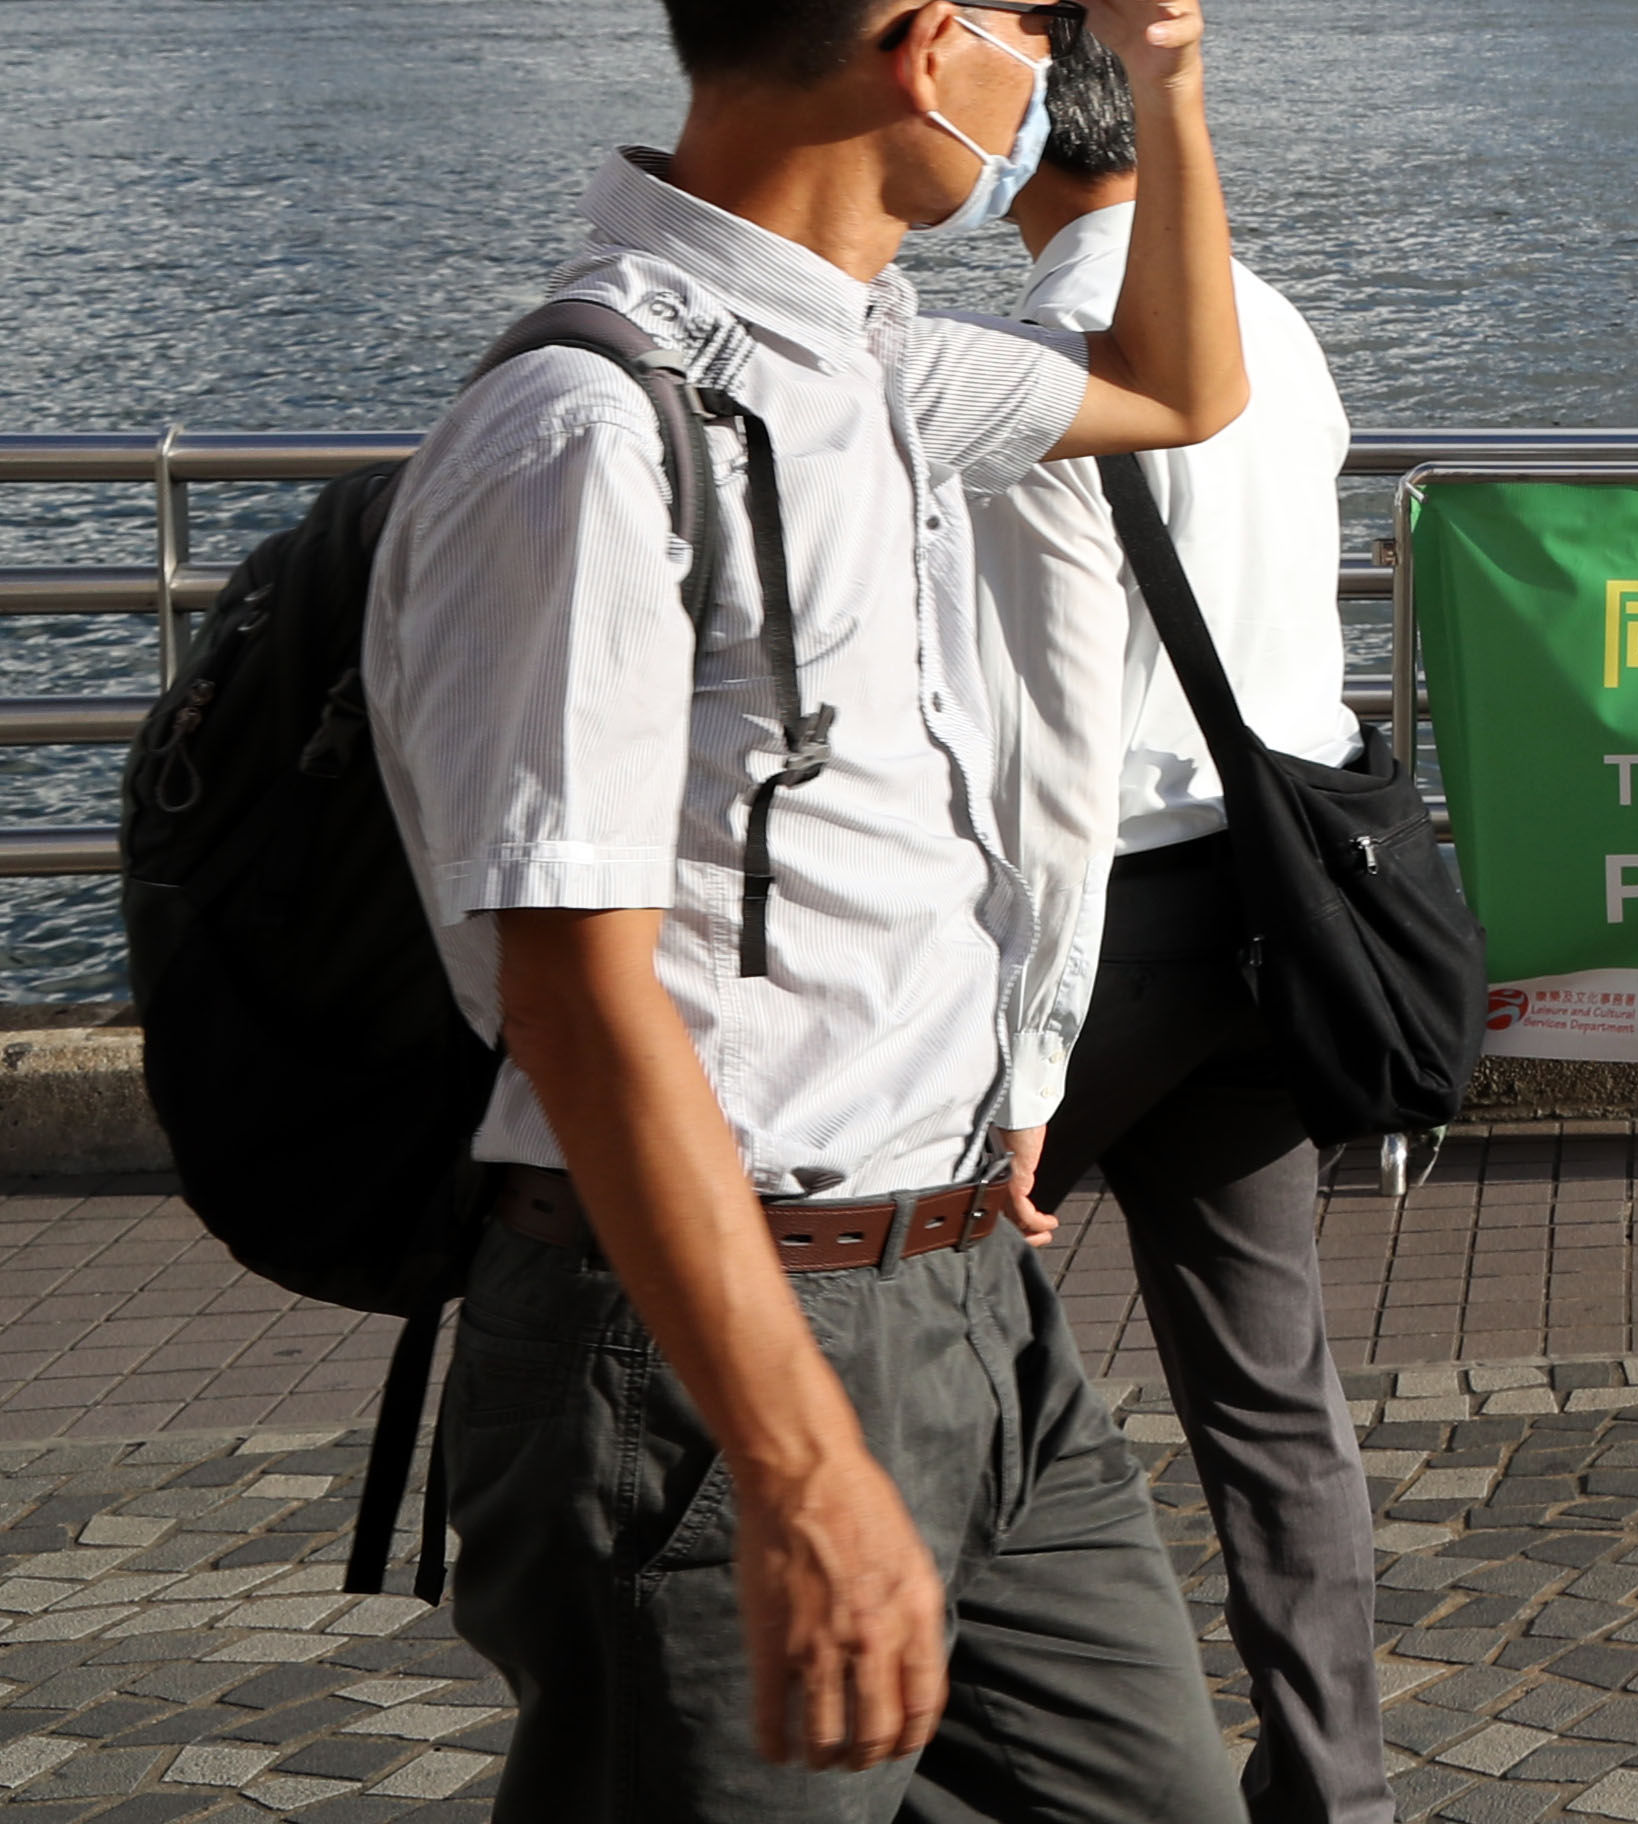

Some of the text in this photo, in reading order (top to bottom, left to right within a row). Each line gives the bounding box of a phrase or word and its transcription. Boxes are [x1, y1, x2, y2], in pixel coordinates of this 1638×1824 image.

[1531, 1005, 1636, 1020] Leisure and Cultural
[1523, 1017, 1635, 1035] Services Department
